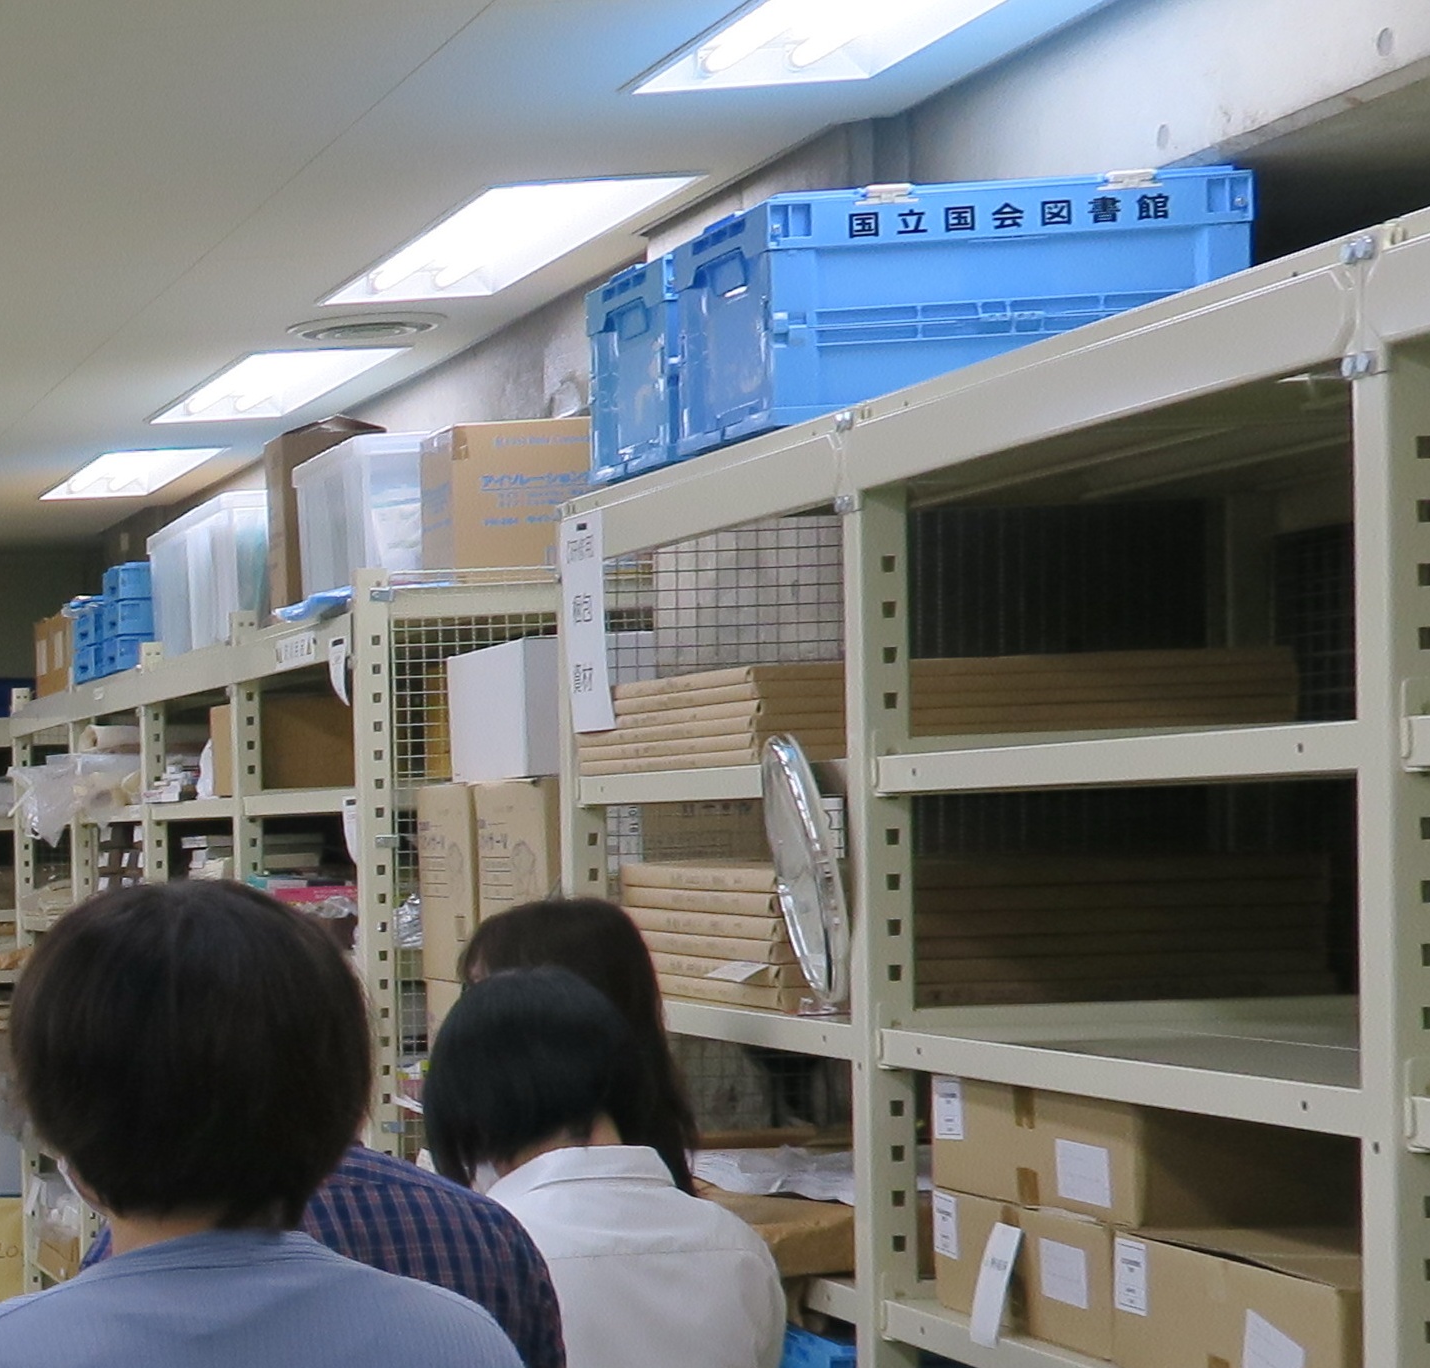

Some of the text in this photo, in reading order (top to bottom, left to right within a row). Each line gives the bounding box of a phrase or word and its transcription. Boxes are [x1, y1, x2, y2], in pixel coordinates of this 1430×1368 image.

[847, 193, 1170, 239] 国立国会図書館
